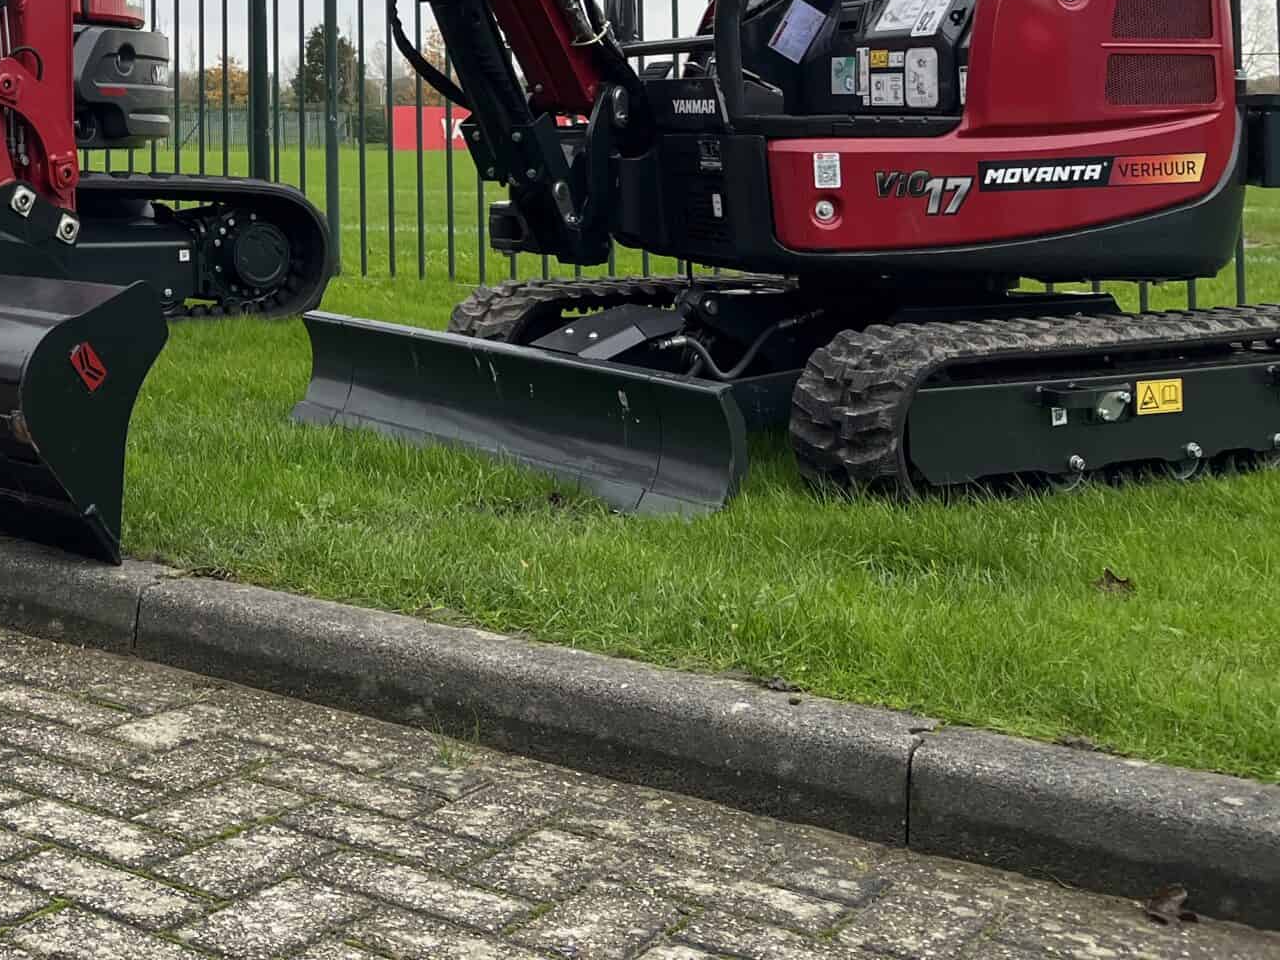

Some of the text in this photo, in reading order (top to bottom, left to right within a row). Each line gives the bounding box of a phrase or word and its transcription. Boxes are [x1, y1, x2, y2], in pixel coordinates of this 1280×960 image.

[671, 98, 716, 114] YANMAR
[983, 160, 1197, 185] MOVANTA VERHUUR
